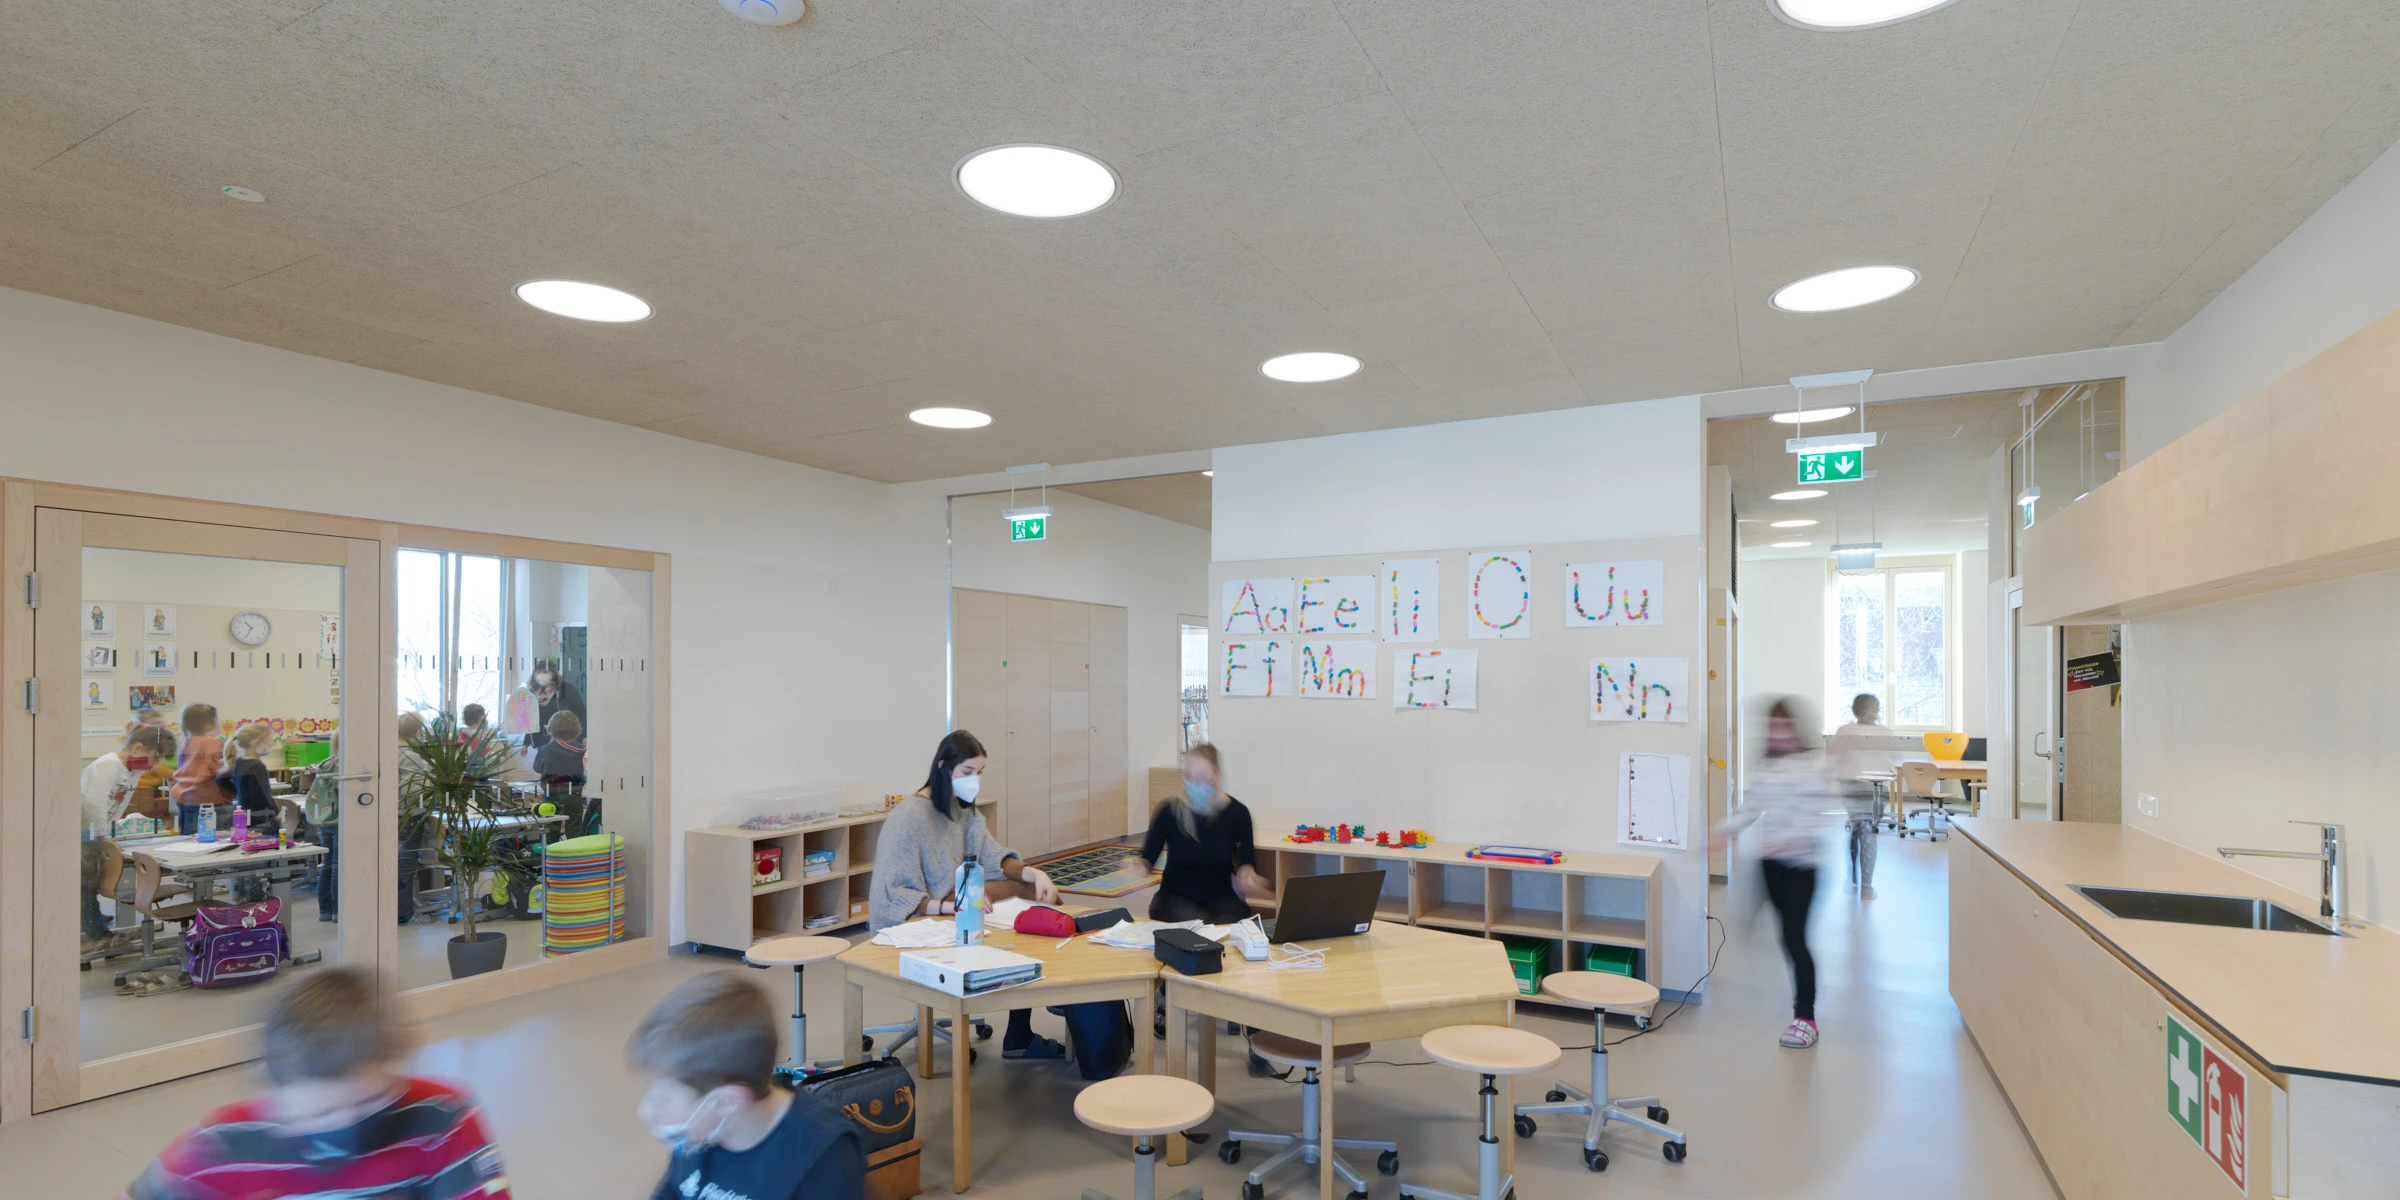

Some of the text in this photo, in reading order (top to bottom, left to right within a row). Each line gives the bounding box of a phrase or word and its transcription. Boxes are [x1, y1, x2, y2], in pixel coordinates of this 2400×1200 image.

[1225, 581, 1287, 634] Aa
[1300, 579, 1359, 633] Ee
[1474, 555, 1528, 629] O
[1573, 566, 1649, 620] Uu
[1301, 645, 1365, 697] Mm
[1596, 662, 1672, 720] Nn
